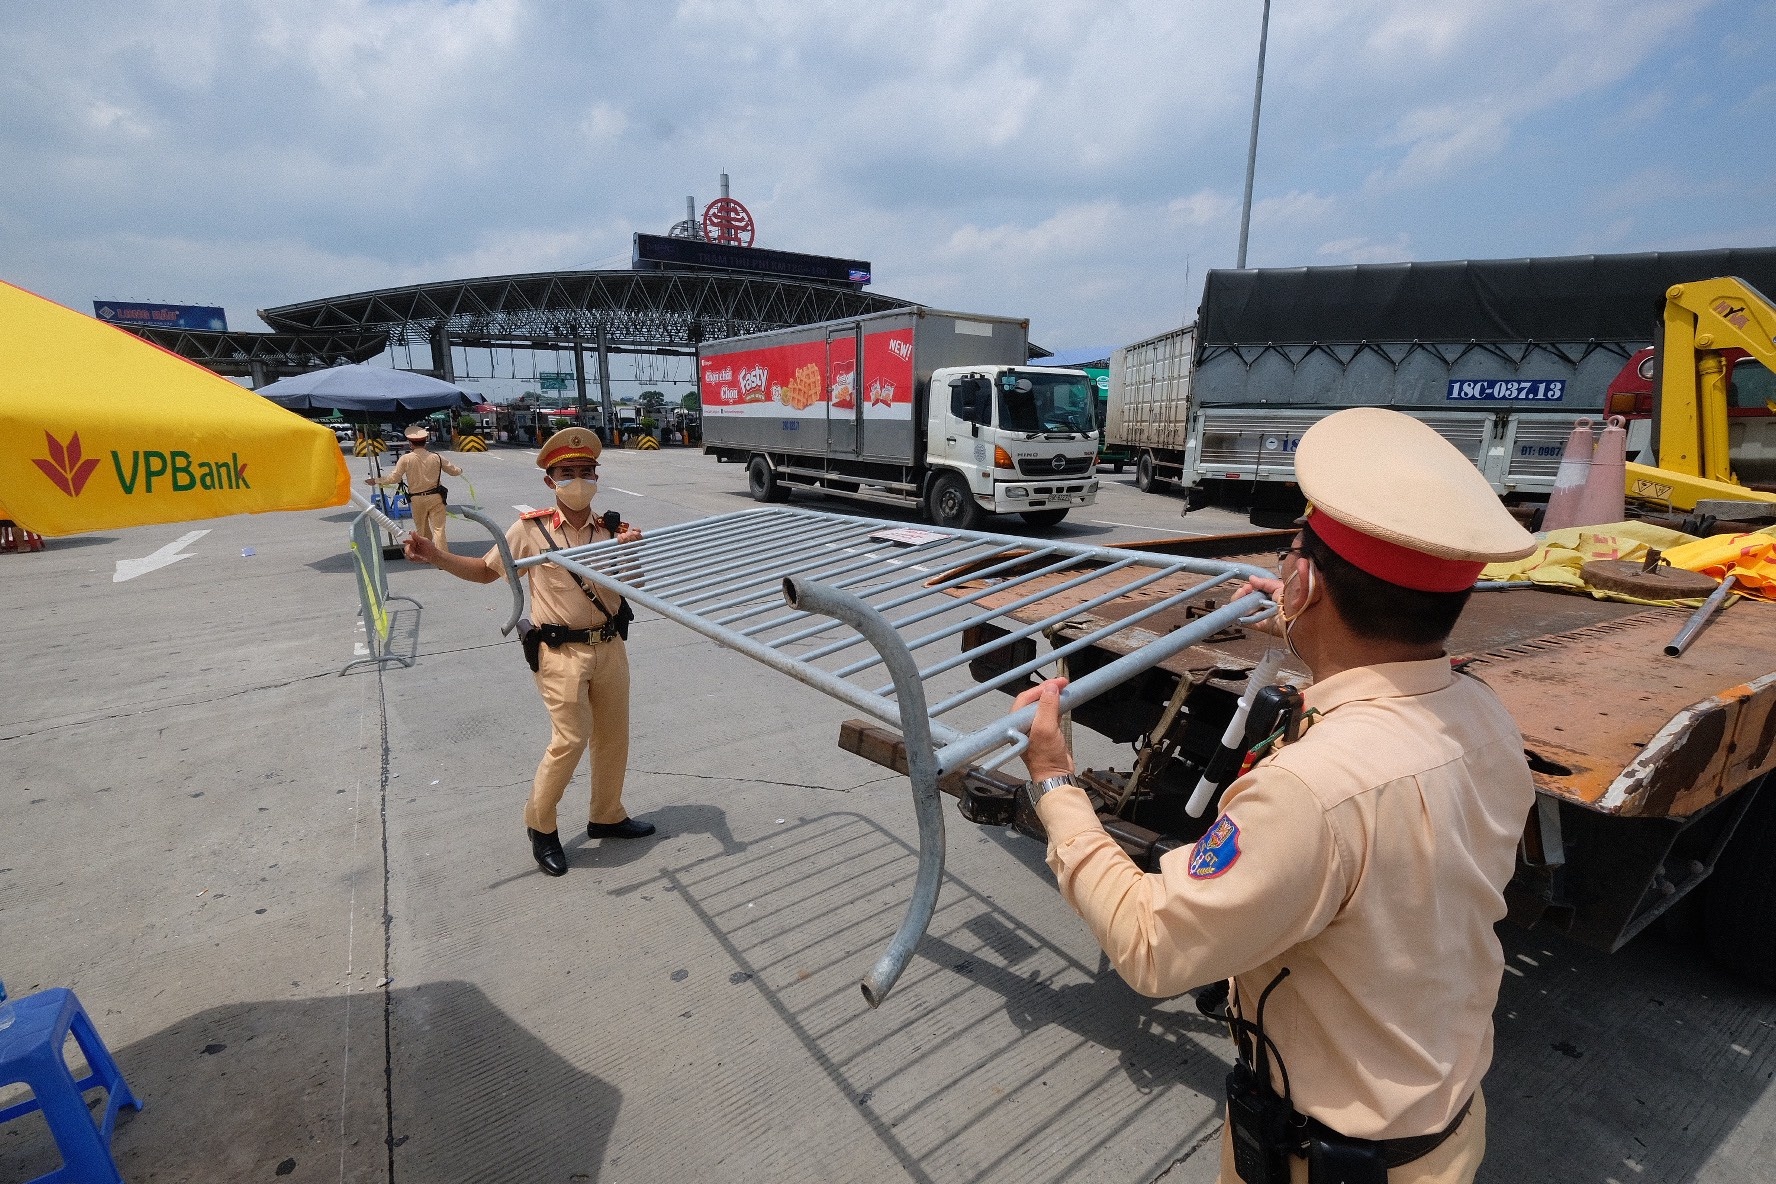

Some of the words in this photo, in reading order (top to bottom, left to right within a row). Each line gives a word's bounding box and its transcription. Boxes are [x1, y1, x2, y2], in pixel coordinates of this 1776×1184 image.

[889, 338, 913, 361] NEW!
[739, 365, 769, 395] Fasty
[1449, 381, 1562, 399] 18C-037.13
[110, 450, 251, 494] VPBank
